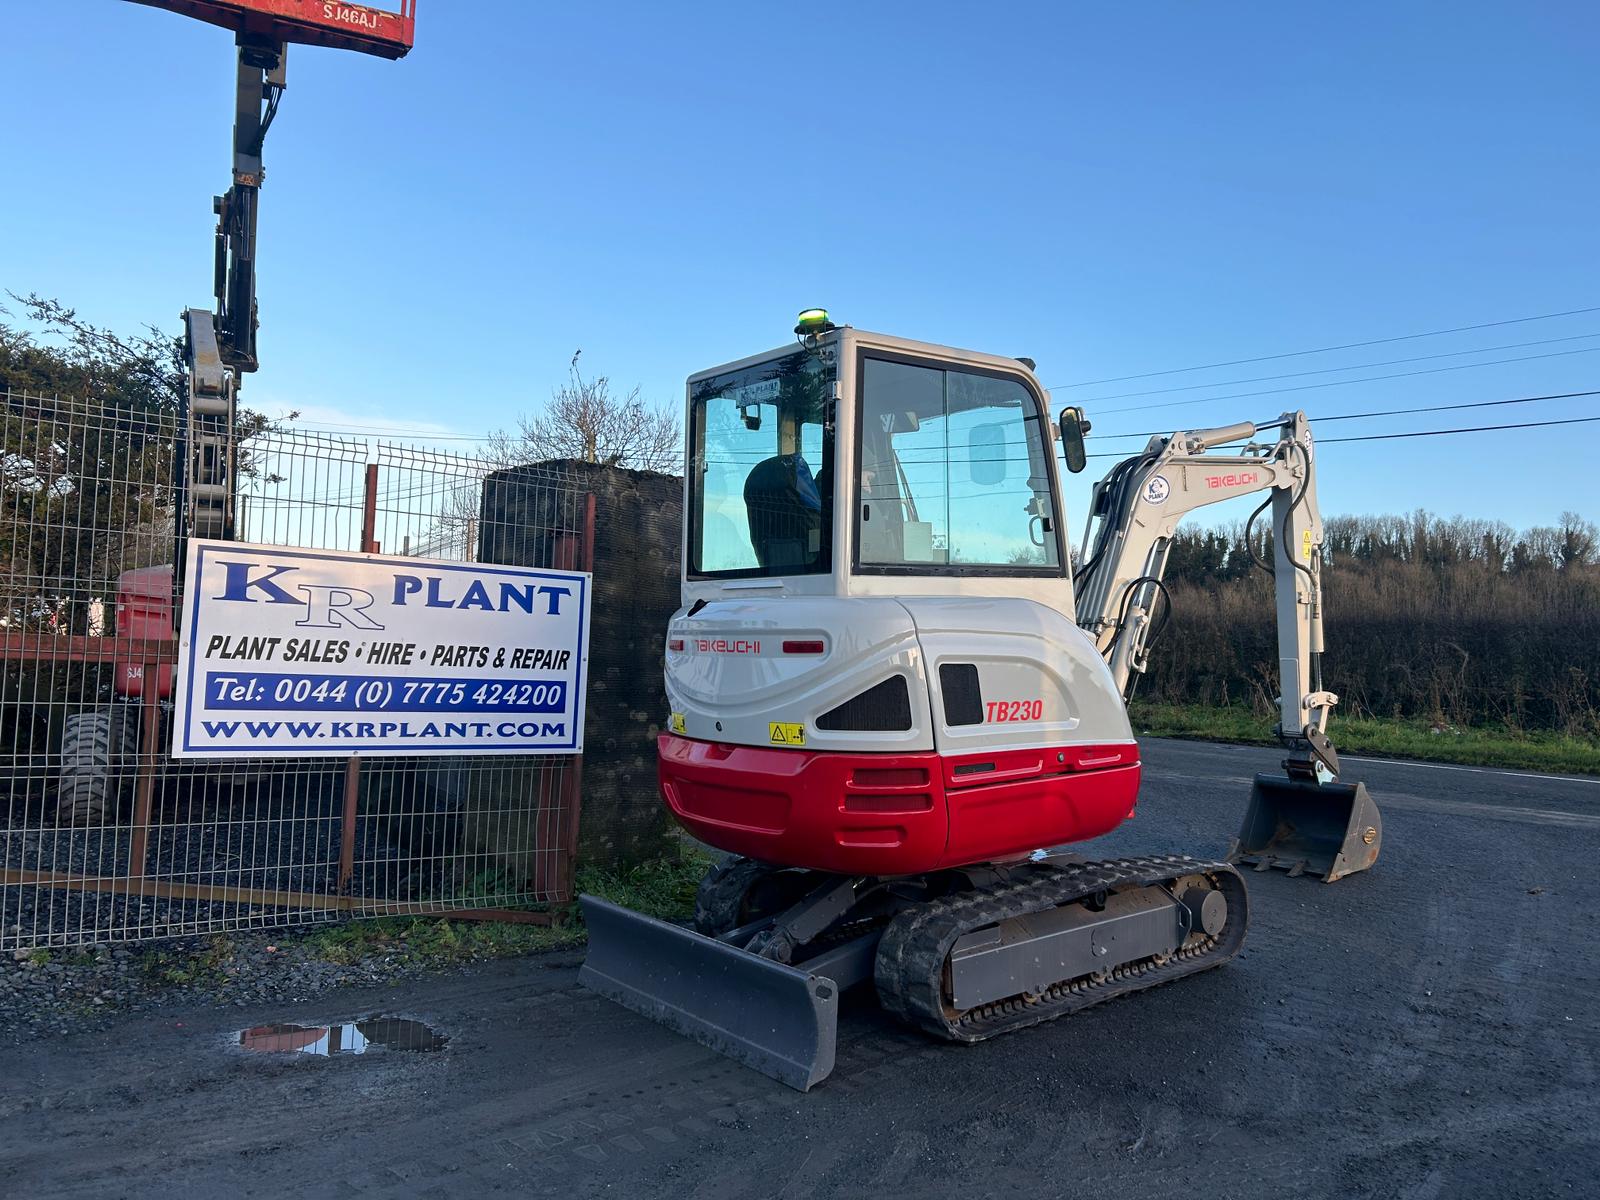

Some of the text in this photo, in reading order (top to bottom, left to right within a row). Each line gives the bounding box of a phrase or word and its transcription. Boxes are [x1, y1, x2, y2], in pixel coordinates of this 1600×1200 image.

[322, 4, 377, 28] SJ46AJ
[391, 574, 571, 615] PLANT
[205, 635, 571, 670] PLANT SALES HIRE PARTS & REPAIR
[214, 677, 562, 708] Tel: 0044 (0) 7775 424200
[986, 700, 1044, 723] TB230
[201, 720, 566, 738] WWW.KRPLANT.COM
